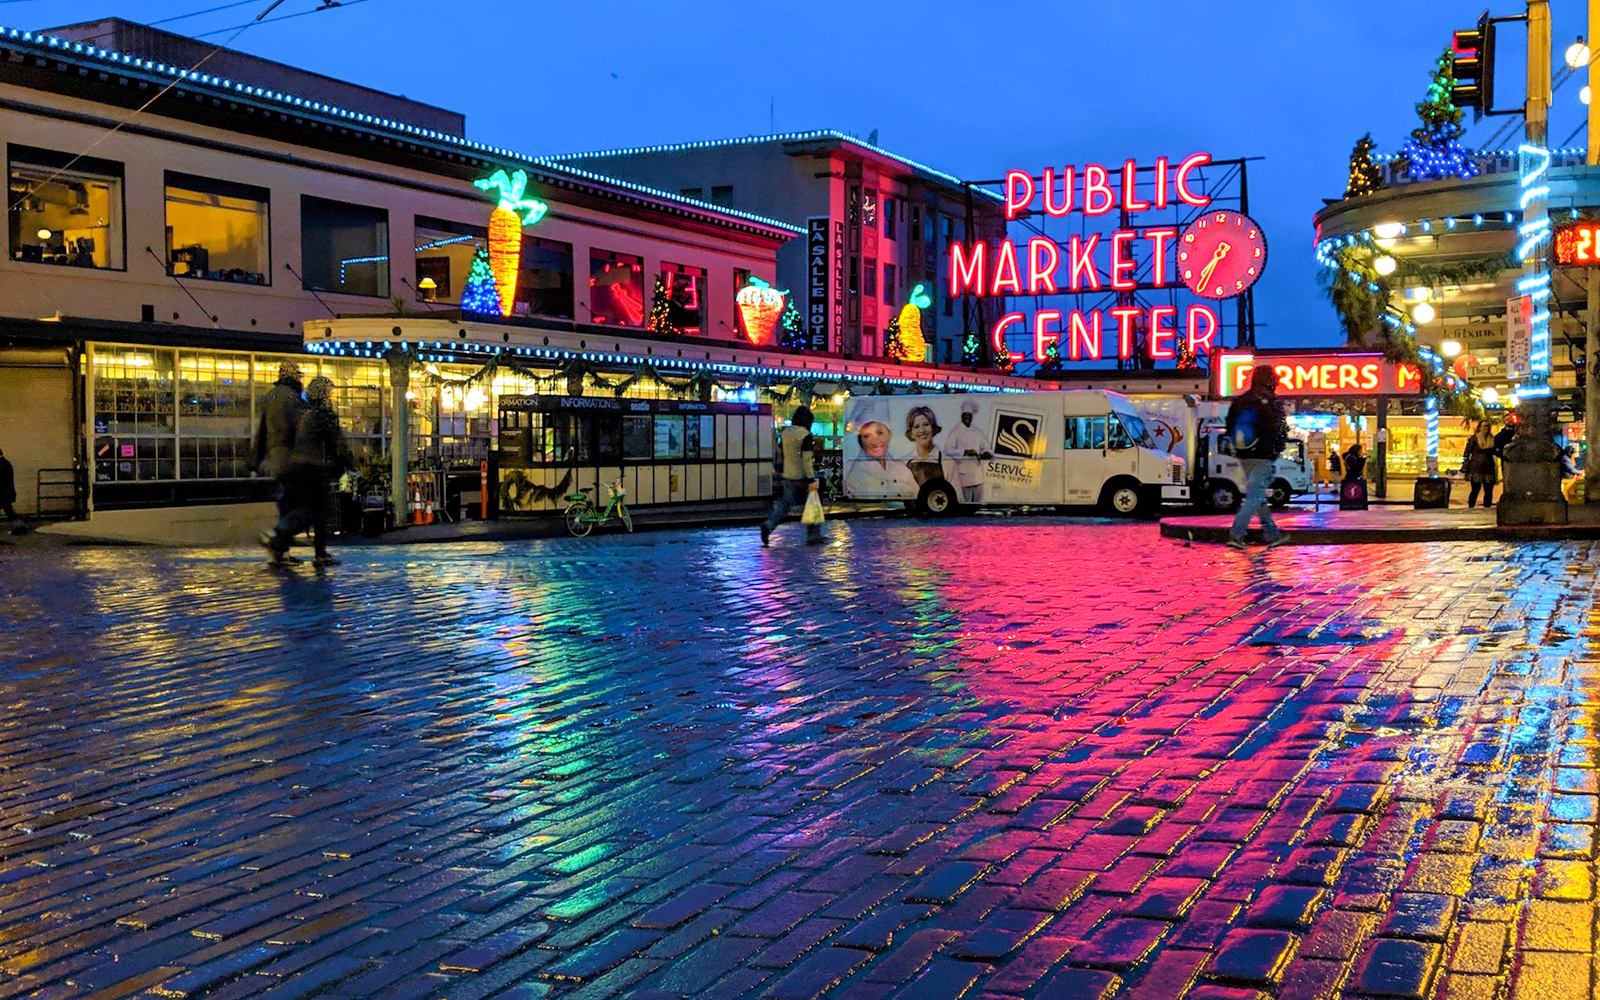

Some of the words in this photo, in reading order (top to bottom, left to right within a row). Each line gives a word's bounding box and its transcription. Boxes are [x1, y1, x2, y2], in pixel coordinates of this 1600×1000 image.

[1005, 153, 1211, 220] PUBLIC
[1215, 213, 1227, 223] 12
[1198, 219, 1207, 229] 11
[811, 221, 825, 242] LA
[835, 222, 843, 244] LA
[1248, 229, 1257, 239] 2
[1184, 233, 1195, 243] 10
[1179, 252, 1188, 261] 9
[1252, 247, 1261, 257] 3
[949, 228, 1178, 298] MARKET
[811, 245, 825, 298] SALLE
[835, 248, 843, 300] SALLE
[1184, 269, 1193, 279] 8
[1247, 266, 1255, 275] 4
[1215, 286, 1224, 295] 6
[1235, 280, 1243, 290] 5
[992, 305, 1219, 363] CENTER
[1470, 365, 1484, 375] The
[1234, 363, 1380, 391] FRMERS
[560, 397, 613, 409] INFORMATION
[630, 400, 650, 411] seattle
[987, 461, 1034, 478] SERVICE
[985, 472, 1006, 480] LINEN
[1008, 475, 1033, 484] SUPPLY
